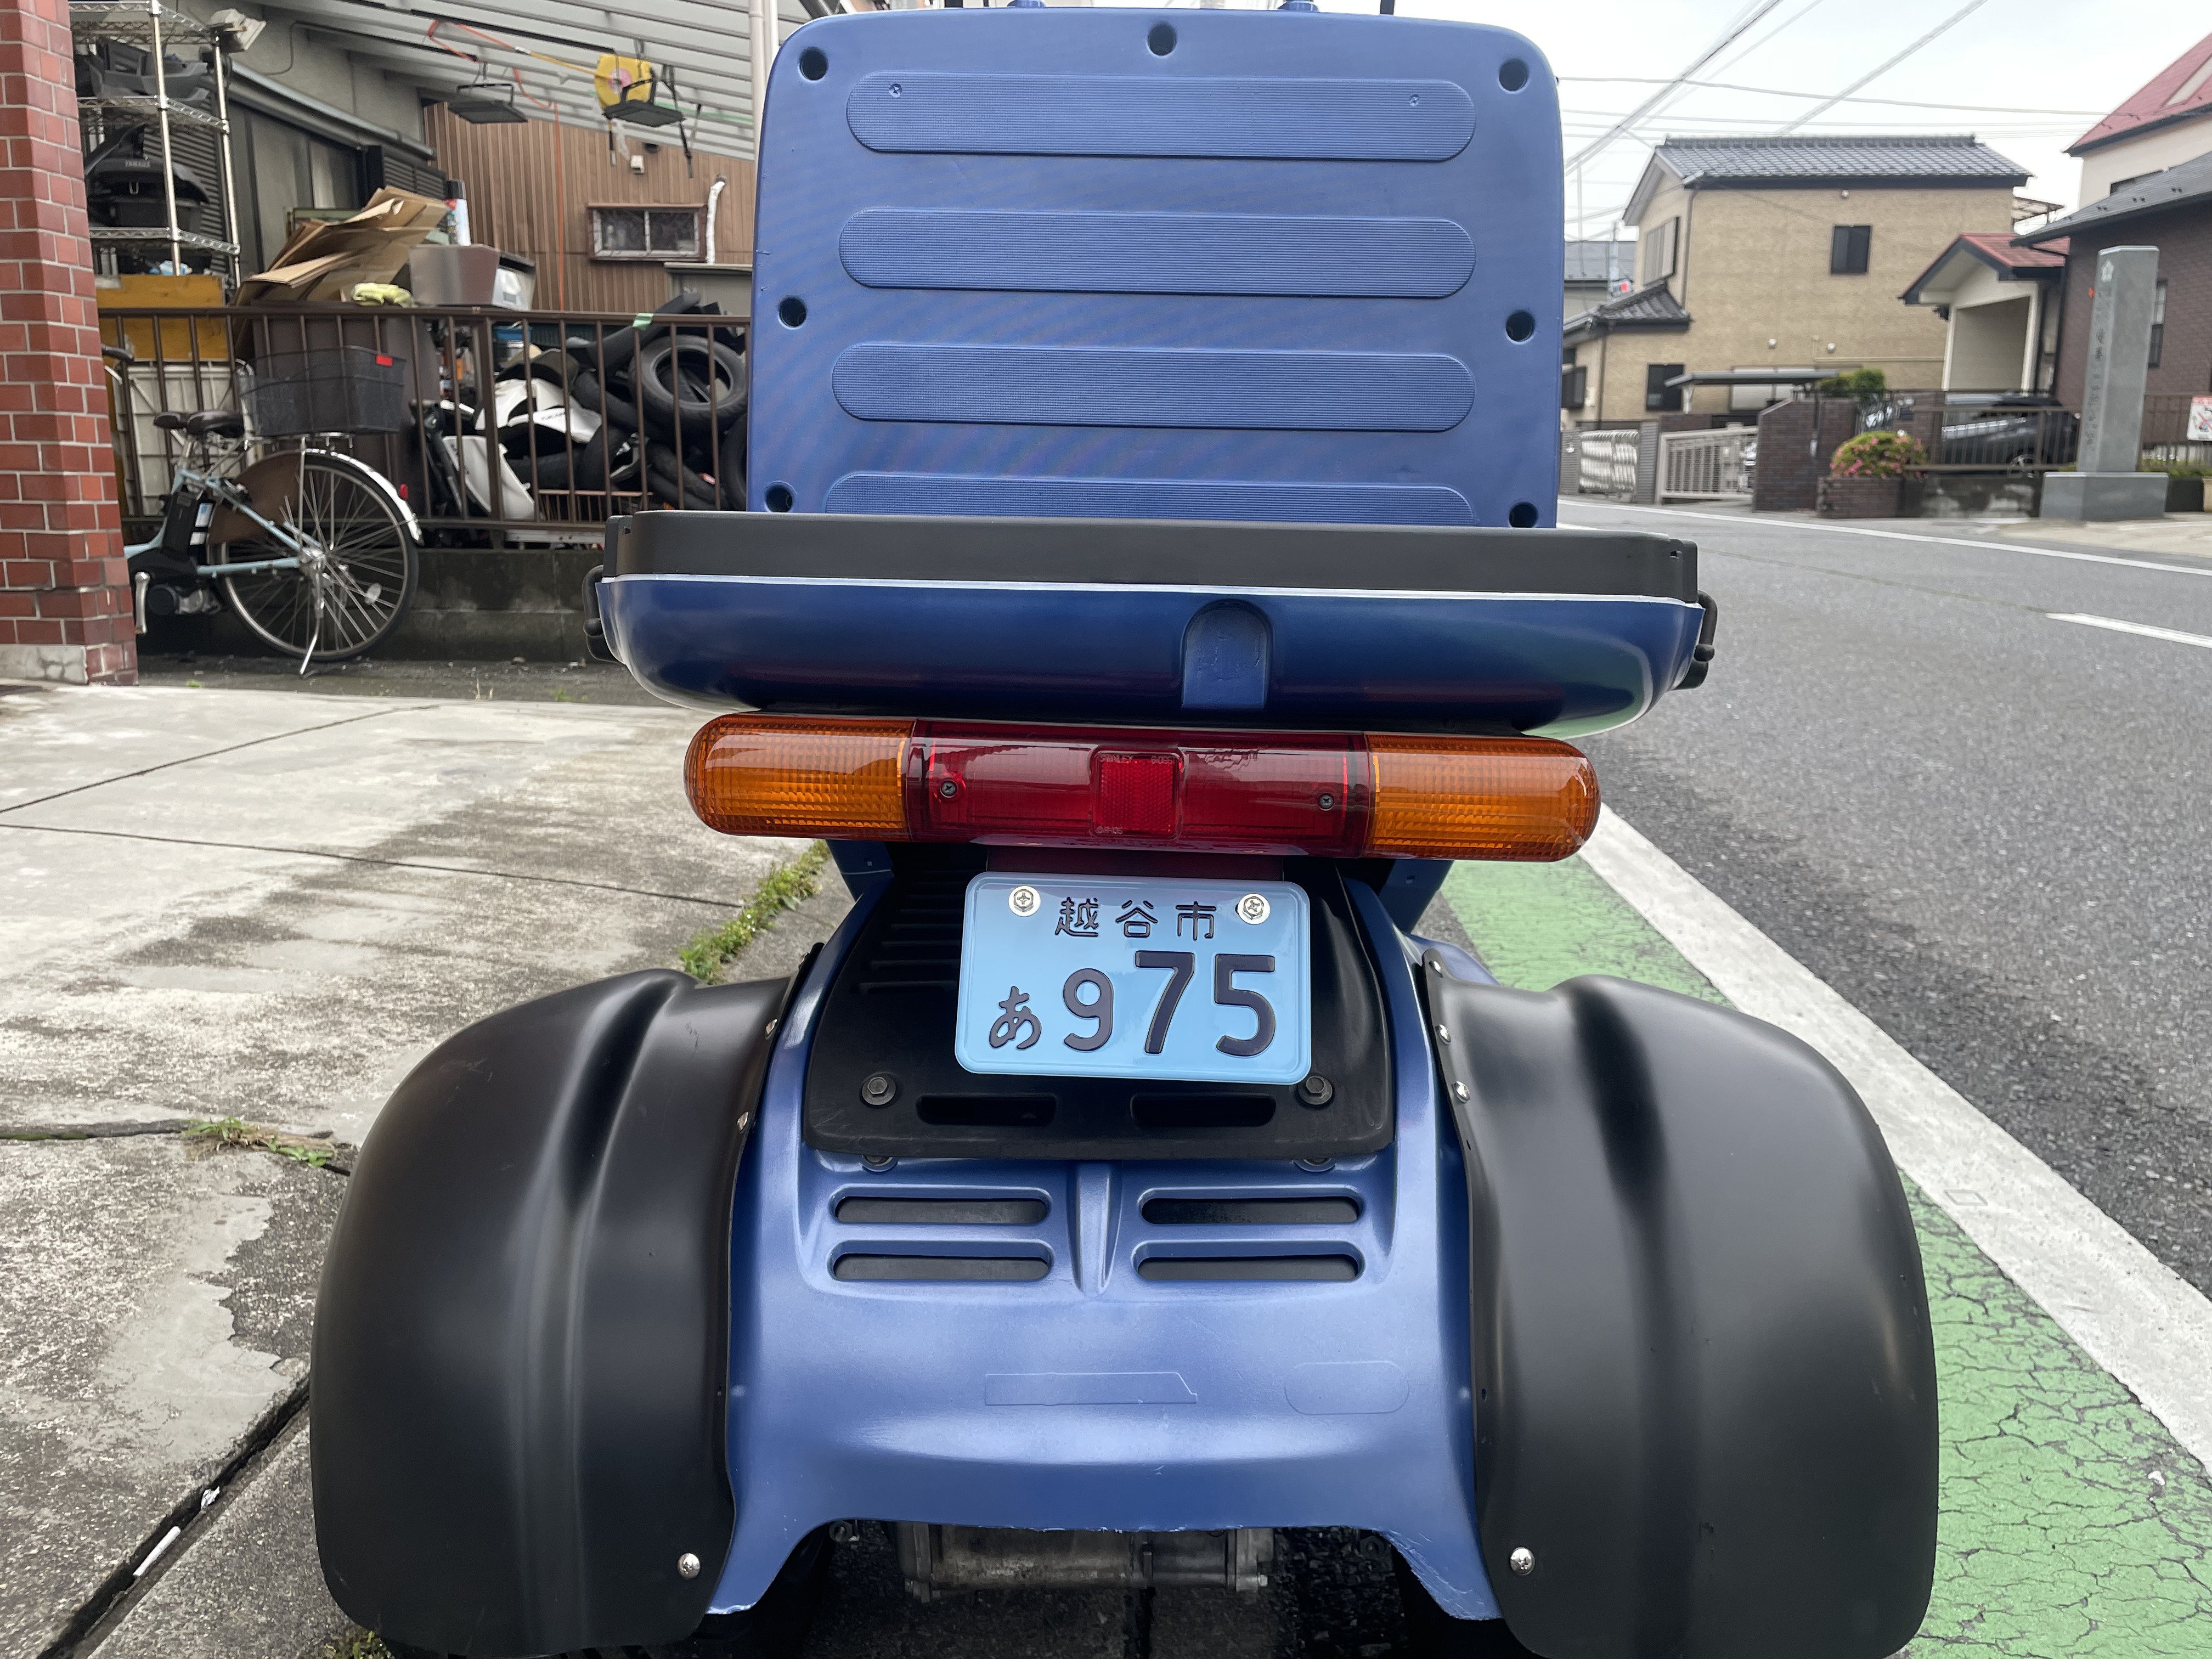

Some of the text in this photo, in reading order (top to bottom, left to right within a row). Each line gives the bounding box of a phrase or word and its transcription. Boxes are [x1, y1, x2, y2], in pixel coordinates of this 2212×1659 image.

[1054, 896, 1217, 941] 越谷市
[988, 949, 1277, 1058] あ 975
